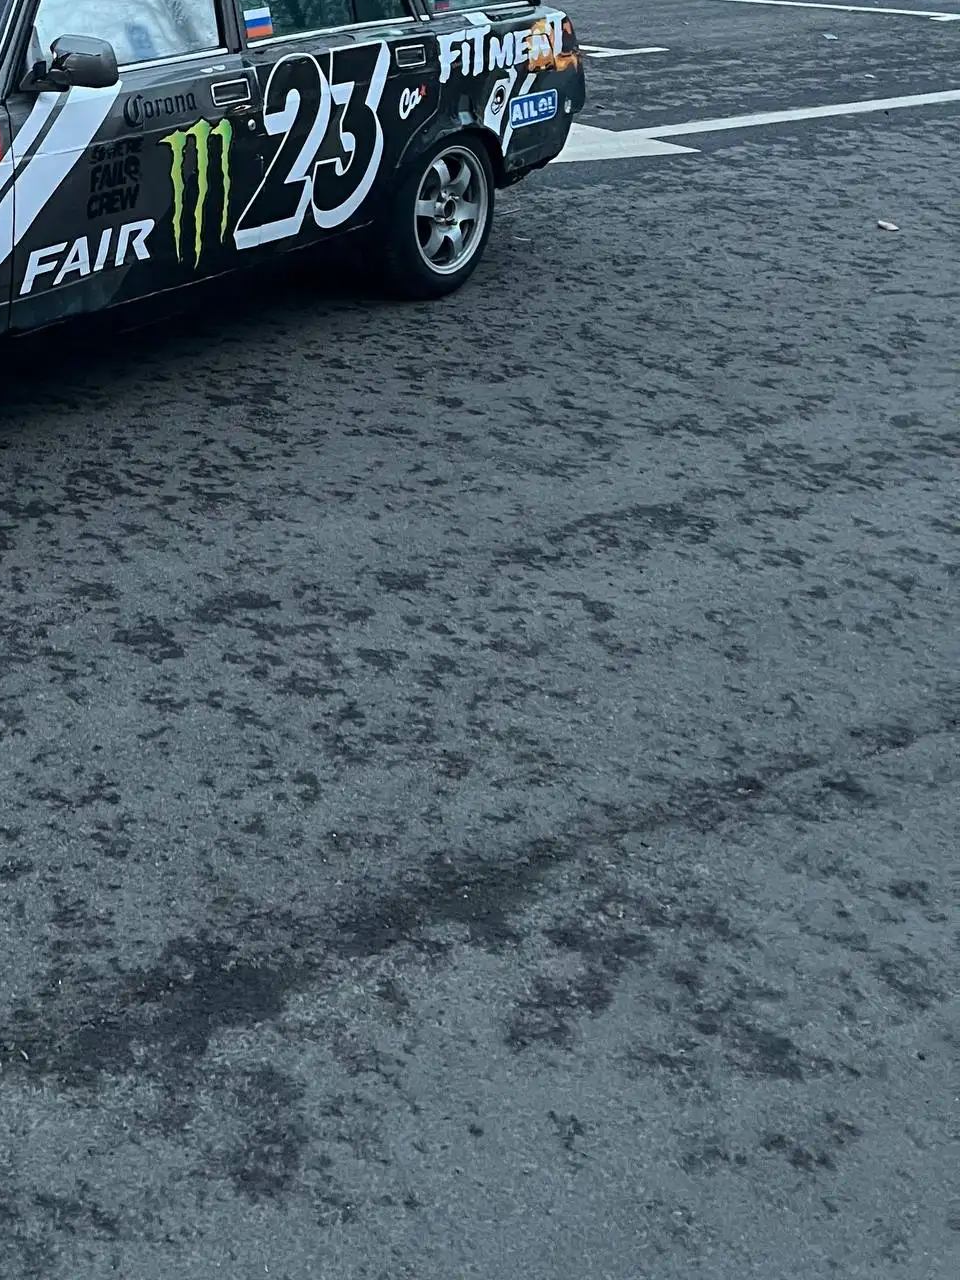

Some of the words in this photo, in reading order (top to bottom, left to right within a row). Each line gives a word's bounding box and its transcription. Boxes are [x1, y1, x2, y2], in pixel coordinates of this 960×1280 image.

[123, 91, 198, 129] Corona
[233, 39, 390, 250] 23
[19, 218, 156, 296] FAIR
